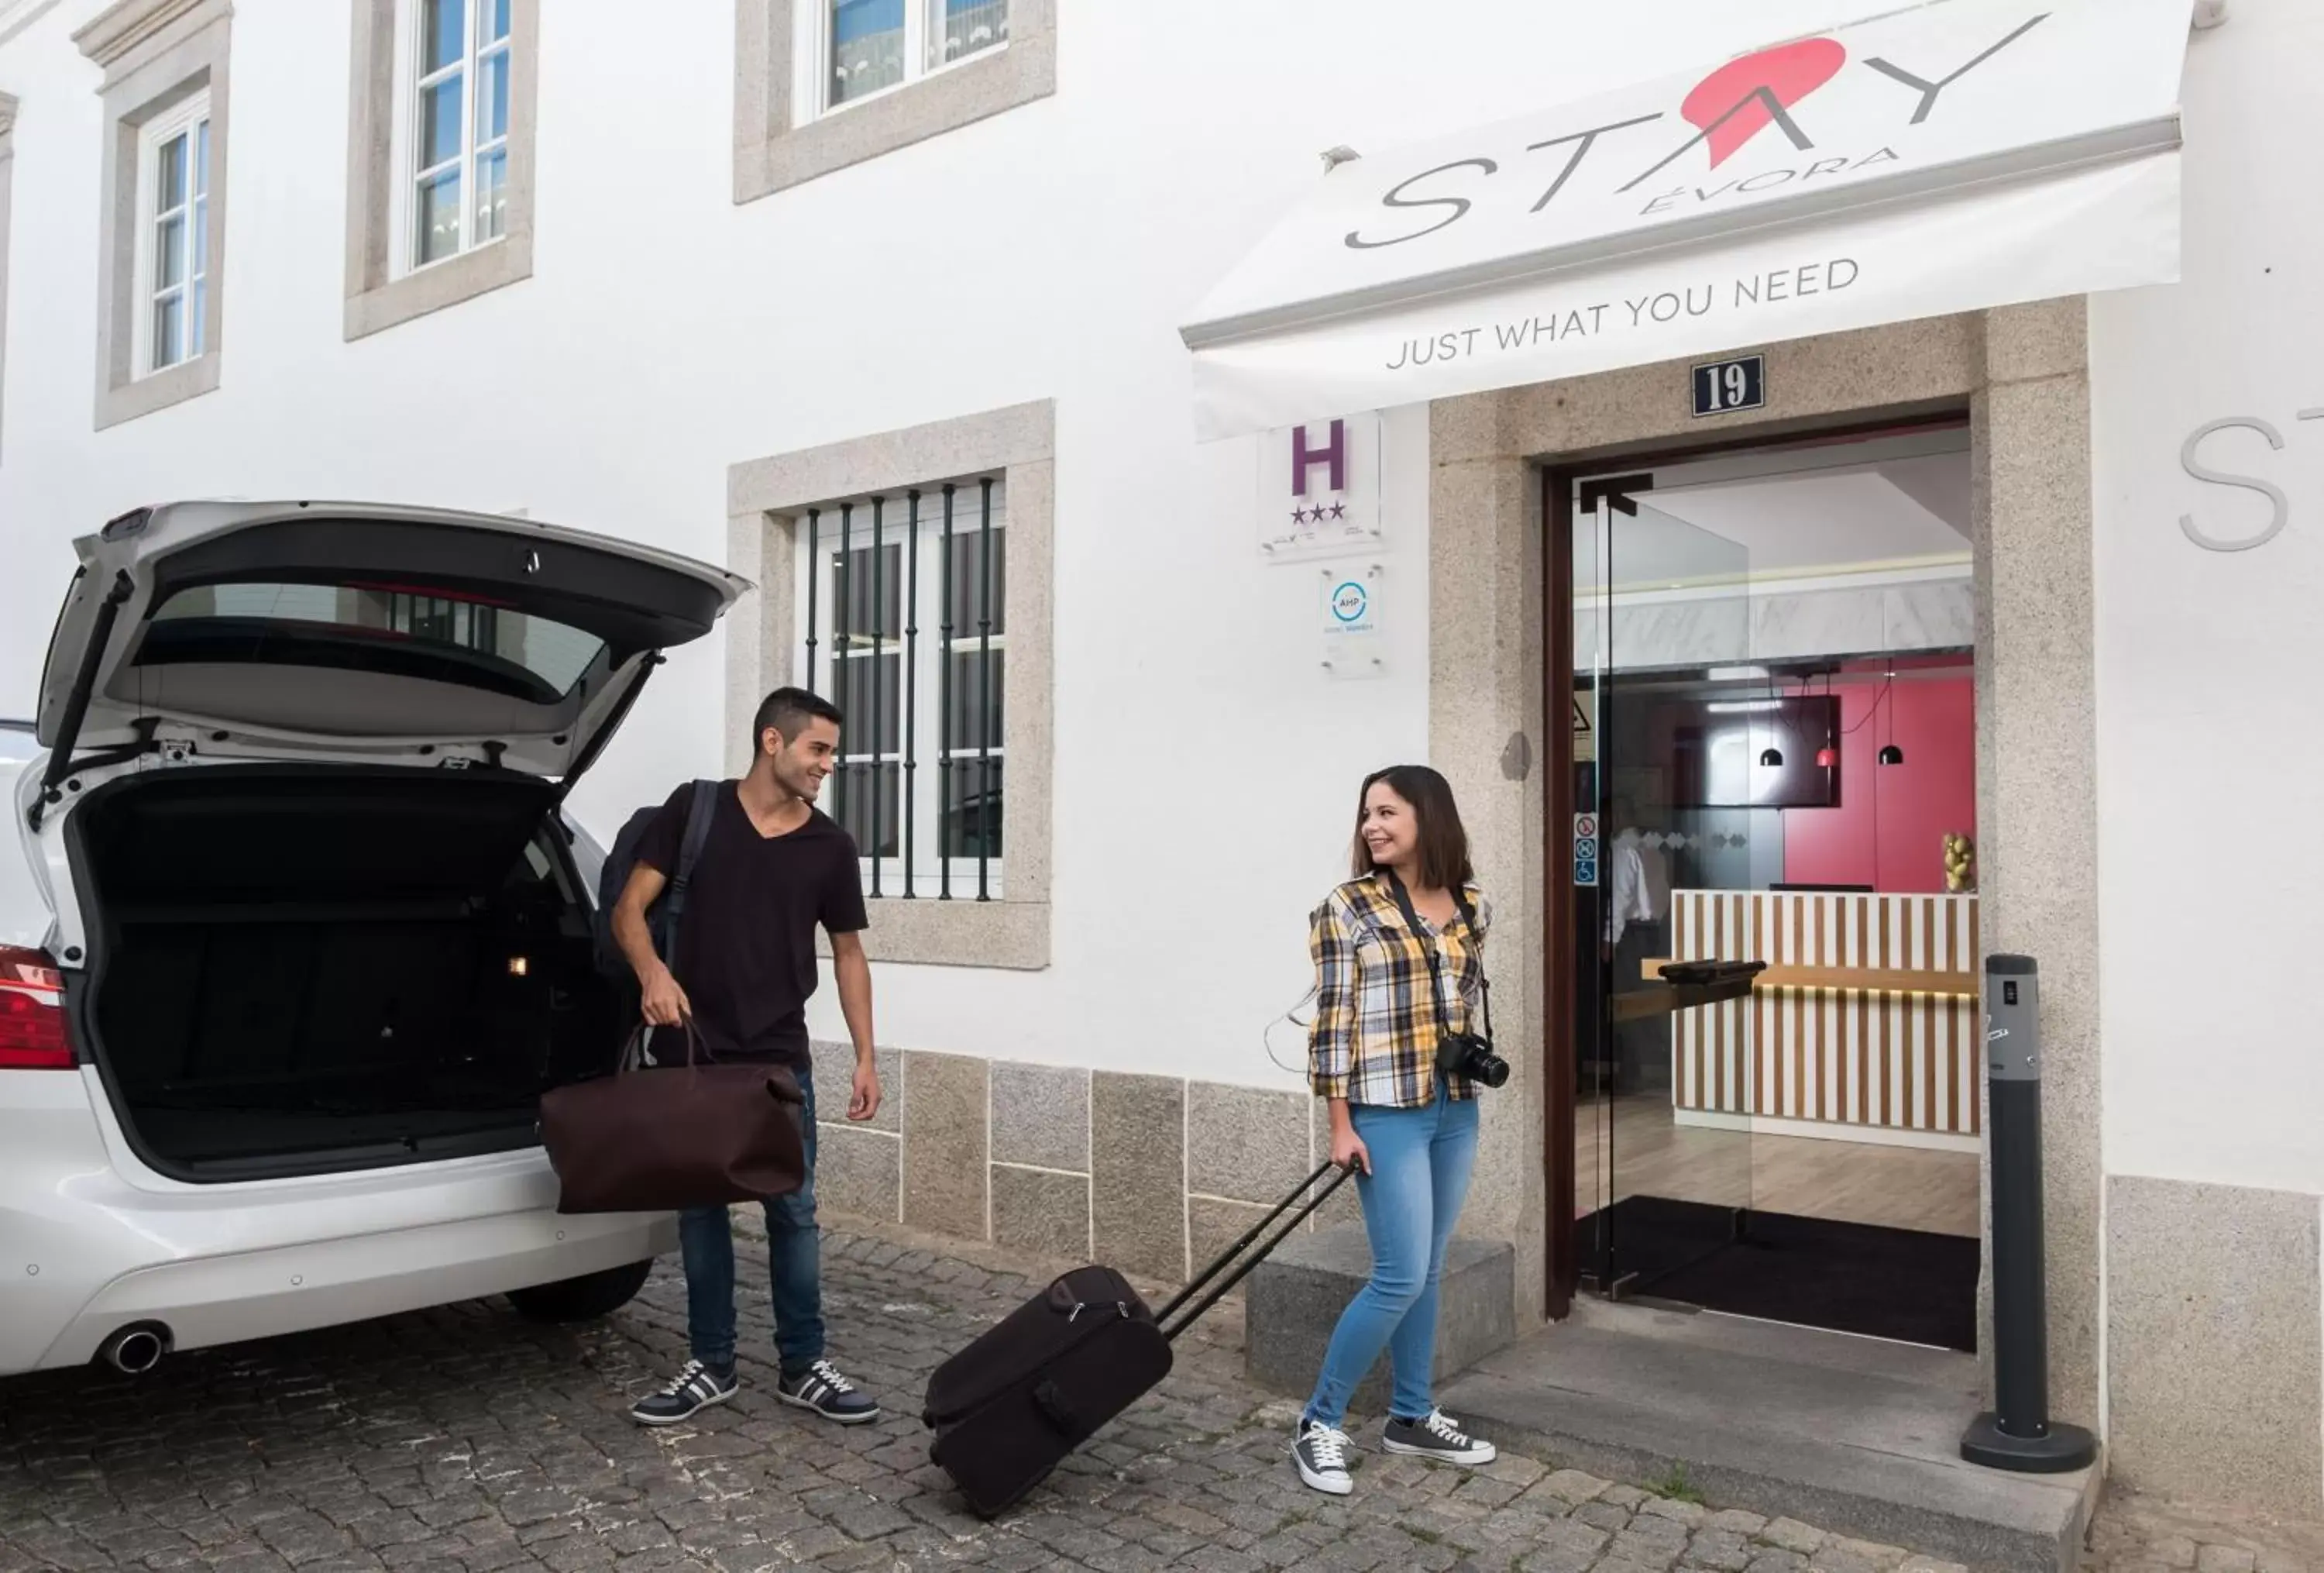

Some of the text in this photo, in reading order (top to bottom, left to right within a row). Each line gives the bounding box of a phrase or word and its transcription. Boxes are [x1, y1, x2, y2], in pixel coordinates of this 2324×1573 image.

[1345, 12, 2053, 249] STAY
[1638, 146, 1899, 215] ÉVORA
[1386, 259, 1859, 370] JUST WHAT YOU NEED
[1707, 363, 1746, 411] 19
[1292, 419, 1343, 496] H
[1339, 597, 1360, 608] AHP
